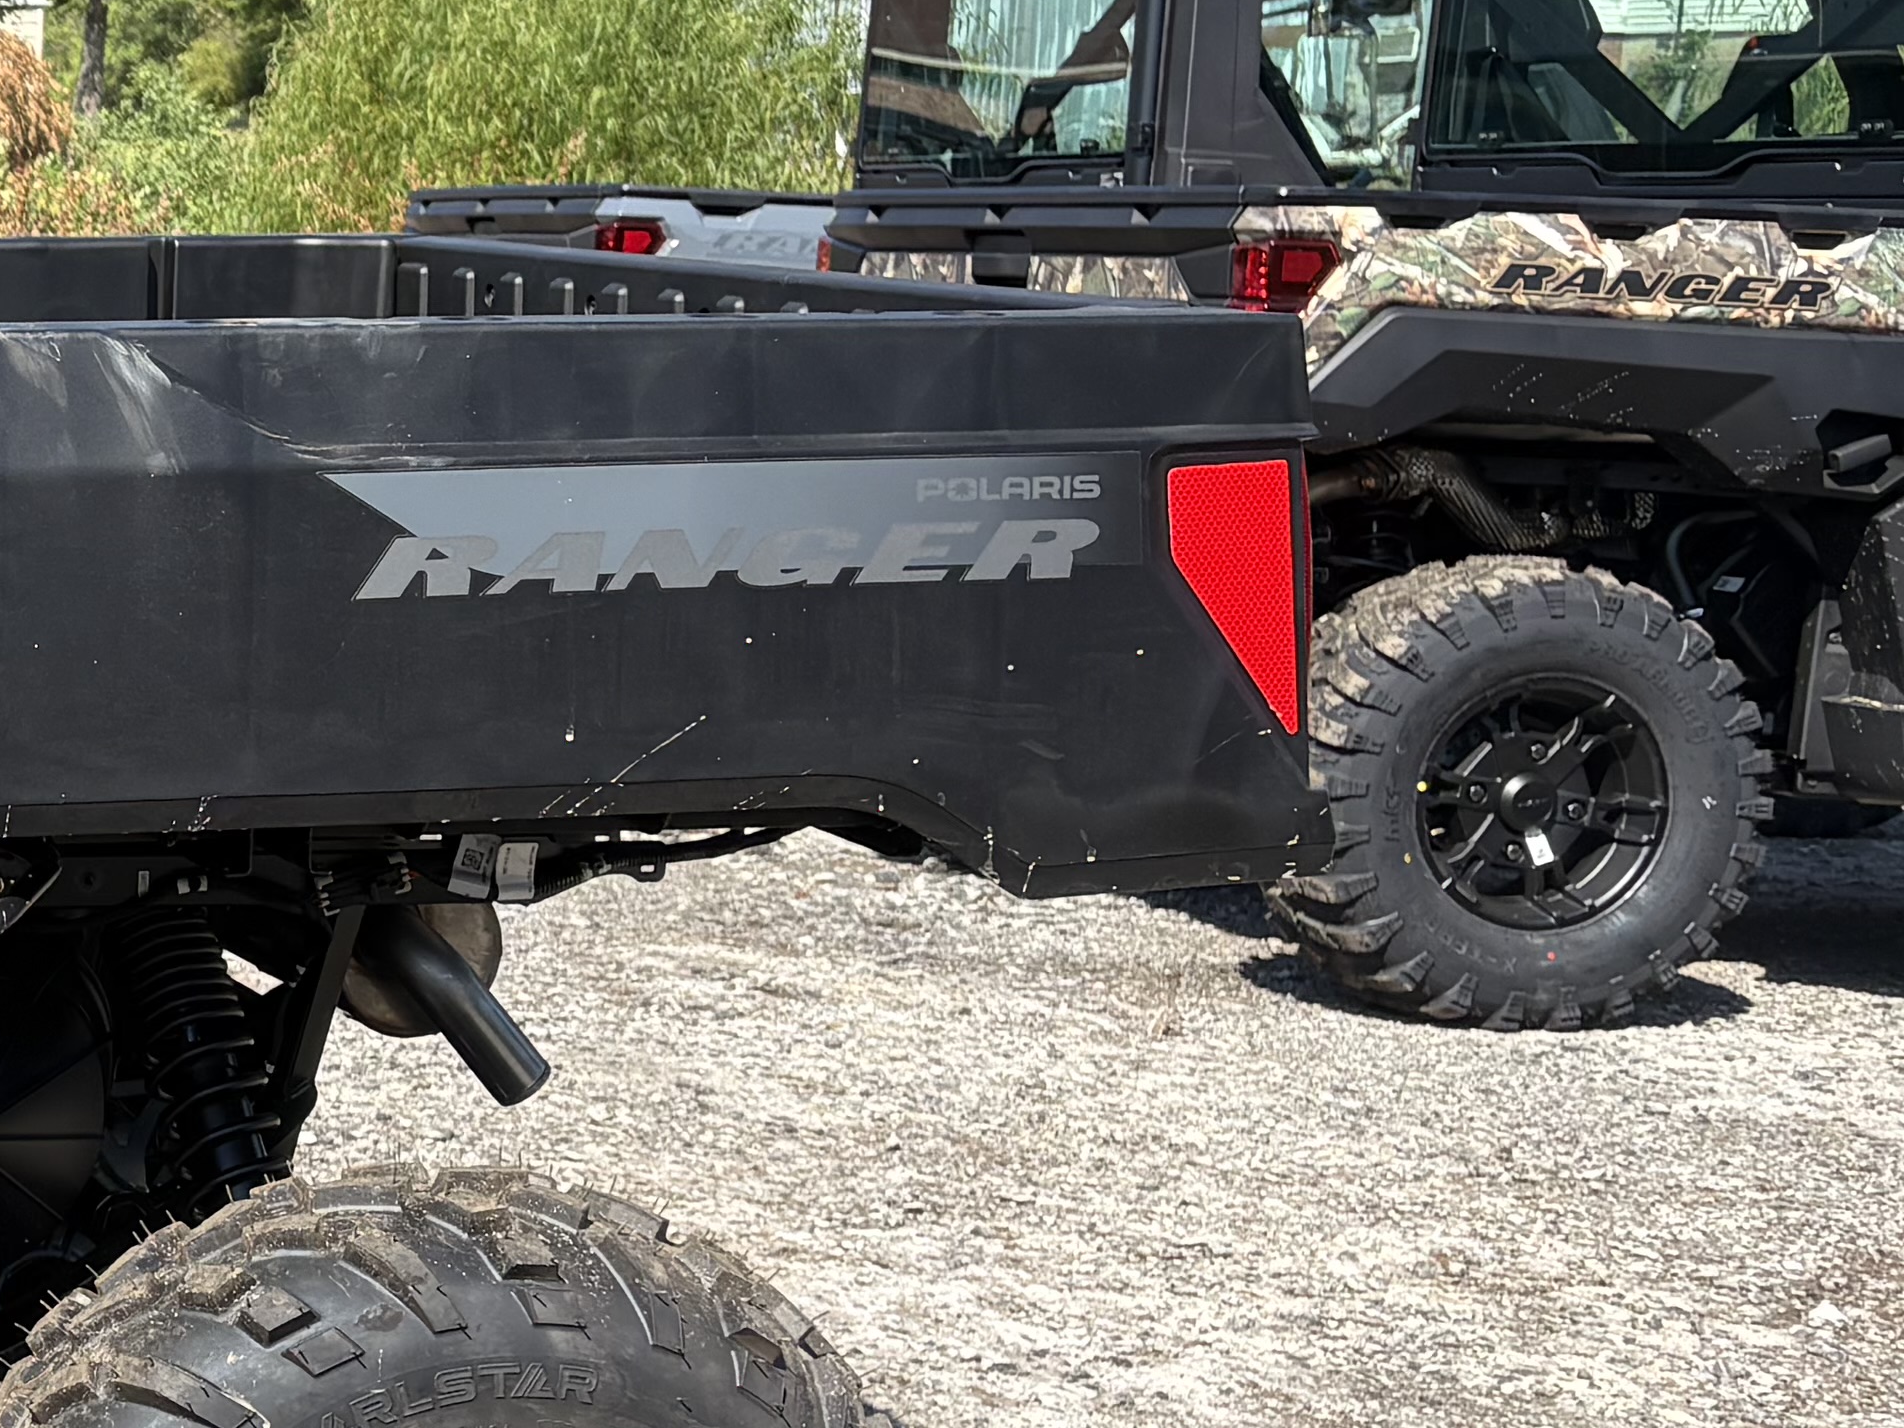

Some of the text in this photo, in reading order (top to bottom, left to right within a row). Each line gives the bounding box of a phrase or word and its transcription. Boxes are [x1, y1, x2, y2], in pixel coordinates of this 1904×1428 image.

[1492, 263, 1833, 310] RANGER
[916, 474, 1102, 501] POLARIS
[354, 518, 1102, 601] RANGER
